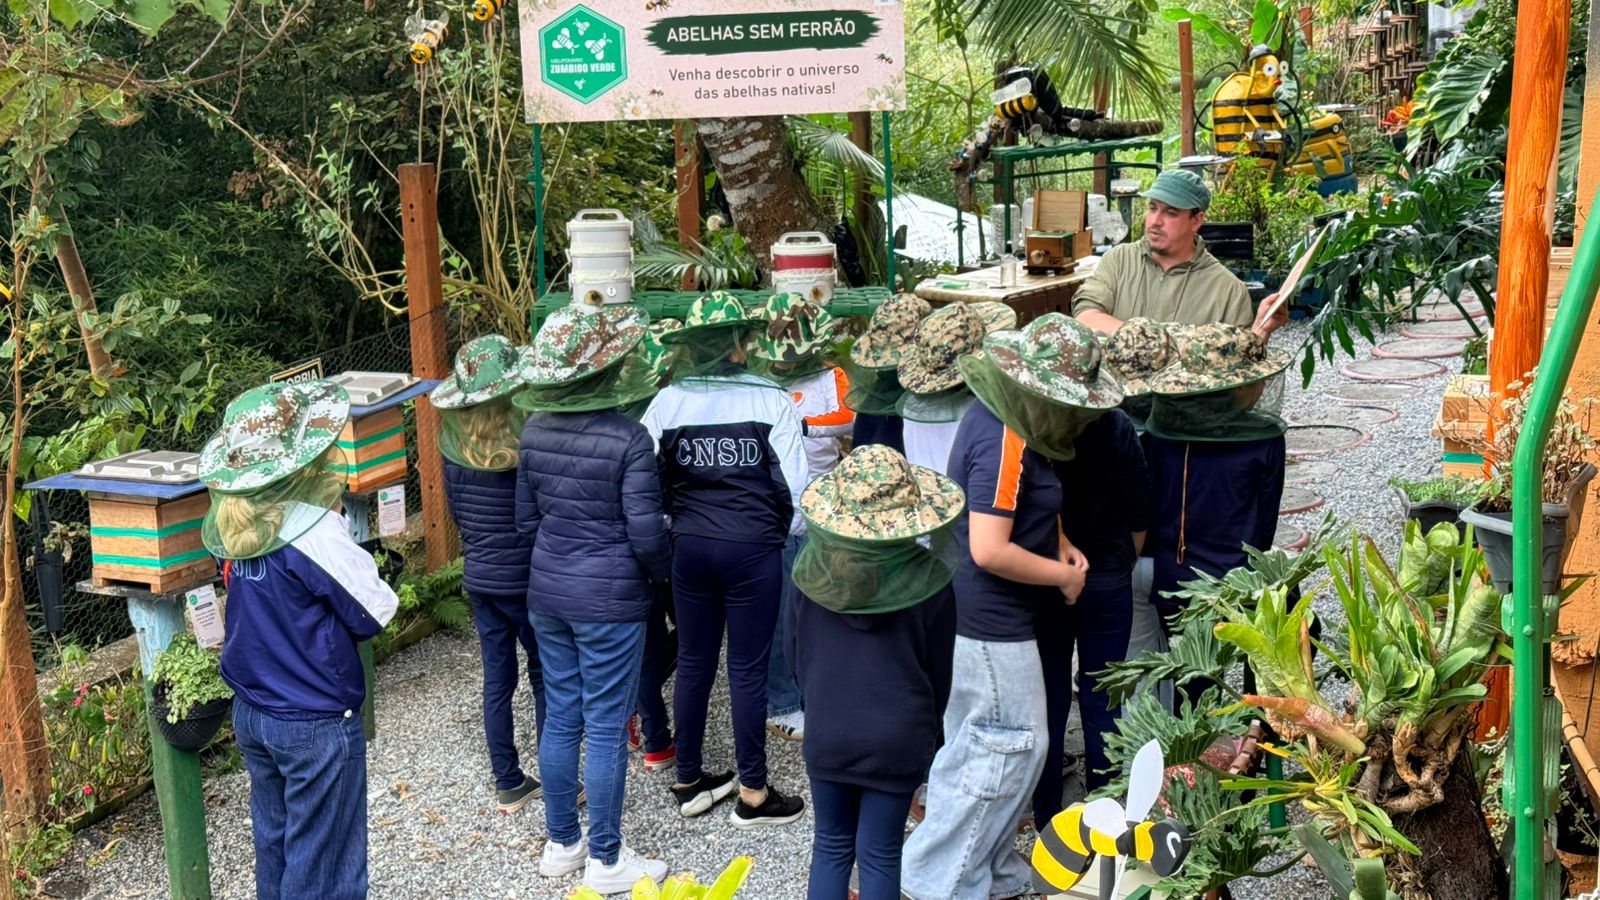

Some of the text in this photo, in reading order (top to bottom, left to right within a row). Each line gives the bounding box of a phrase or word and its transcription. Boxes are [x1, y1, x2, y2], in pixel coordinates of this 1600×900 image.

[667, 18, 856, 43] ABELHAS SEM FERRÃO
[550, 62, 616, 74] ZUMBIDO VERDE
[668, 63, 860, 81] Venha descobrir o universo
[694, 82, 836, 100] das abelhas nativas!
[676, 438, 763, 466] CNSD
